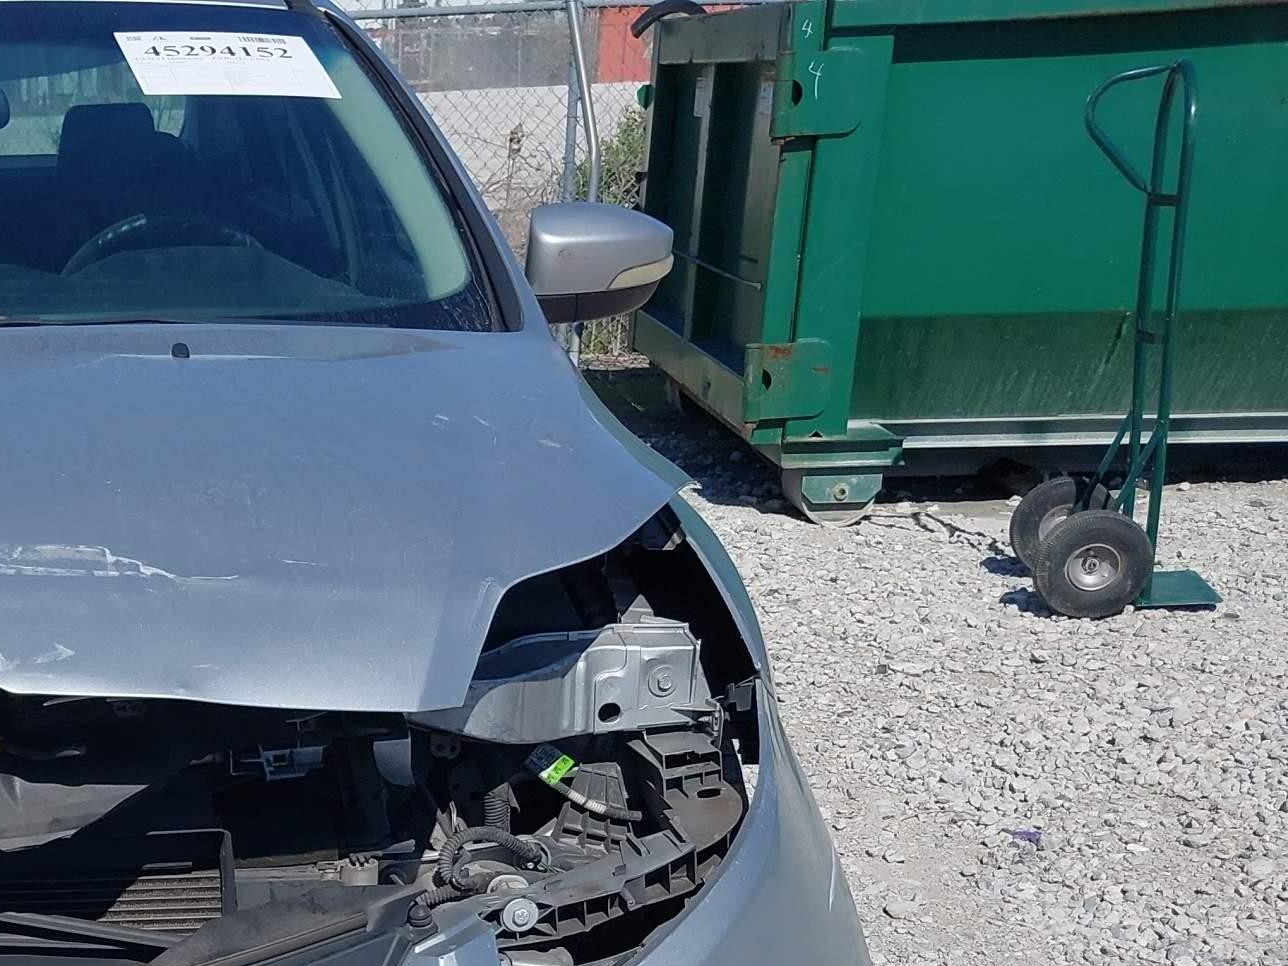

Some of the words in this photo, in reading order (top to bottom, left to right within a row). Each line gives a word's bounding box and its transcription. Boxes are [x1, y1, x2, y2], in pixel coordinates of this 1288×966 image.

[801, 19, 813, 38] 4
[144, 45, 293, 59] 45294152
[808, 61, 825, 100] 4
